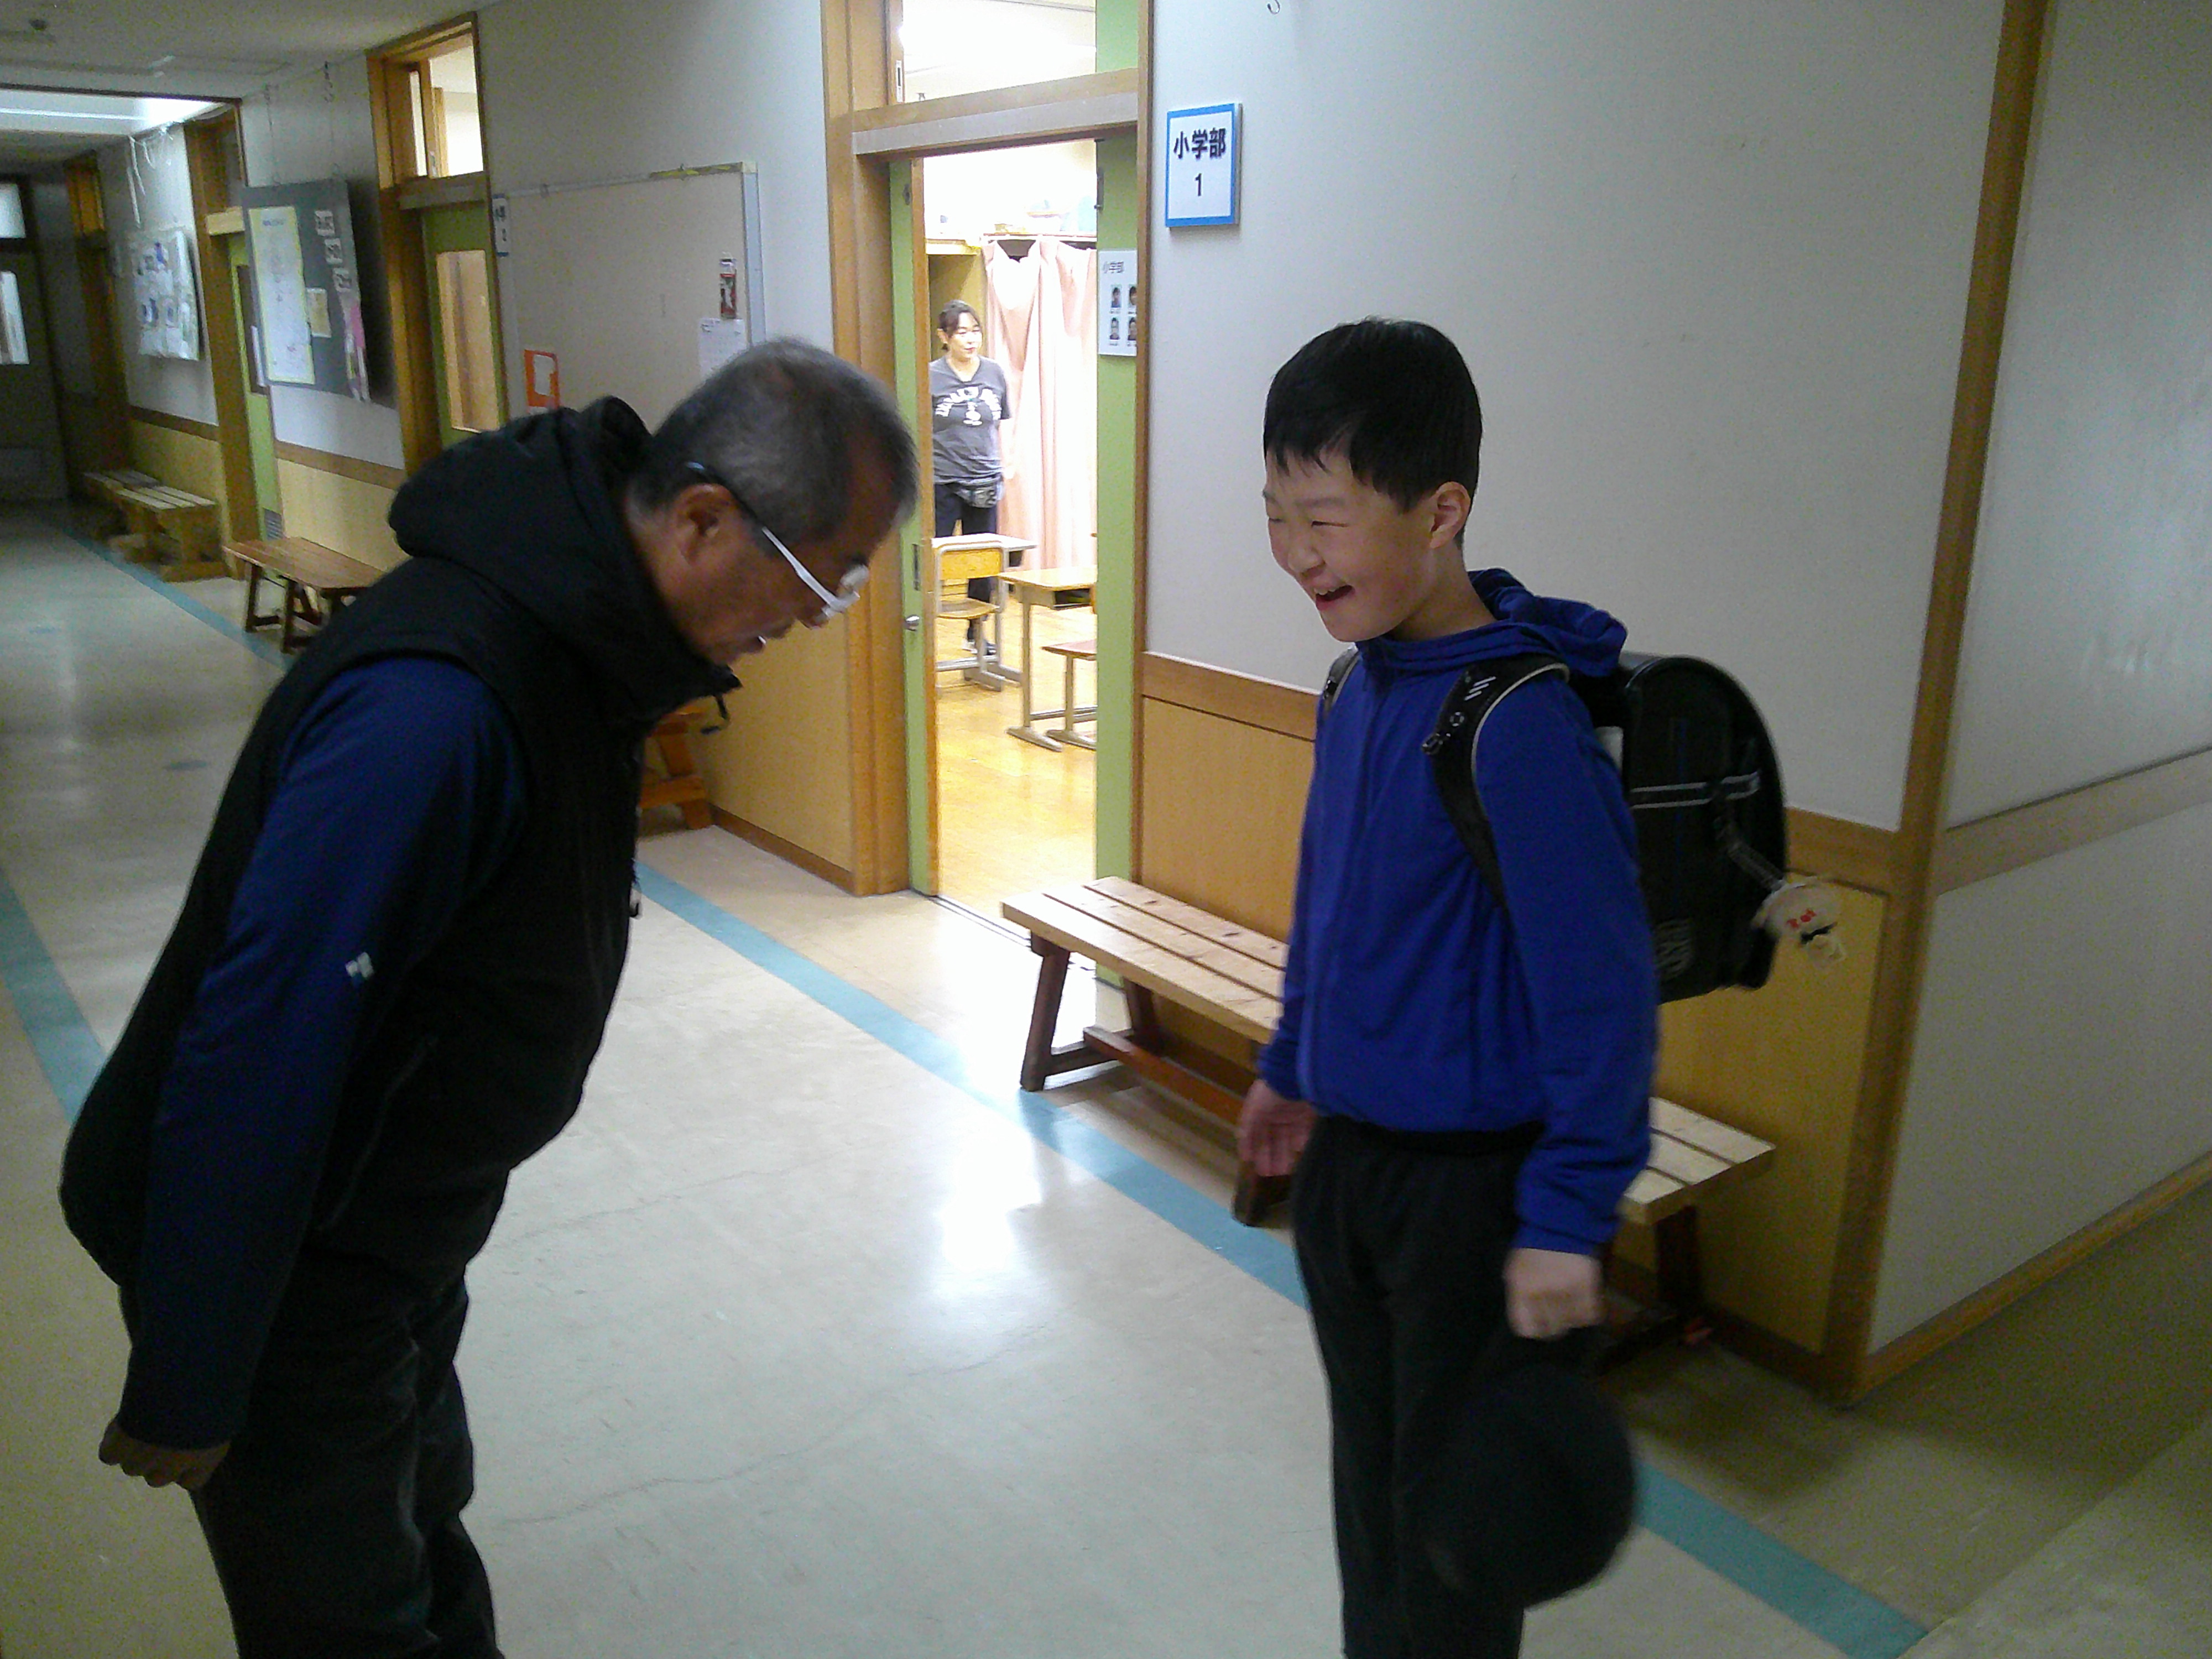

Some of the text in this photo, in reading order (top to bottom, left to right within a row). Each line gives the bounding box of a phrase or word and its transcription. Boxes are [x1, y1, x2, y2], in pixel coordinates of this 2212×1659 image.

[1173, 127, 1226, 159] 小学部
[1195, 173, 1202, 196] 1
